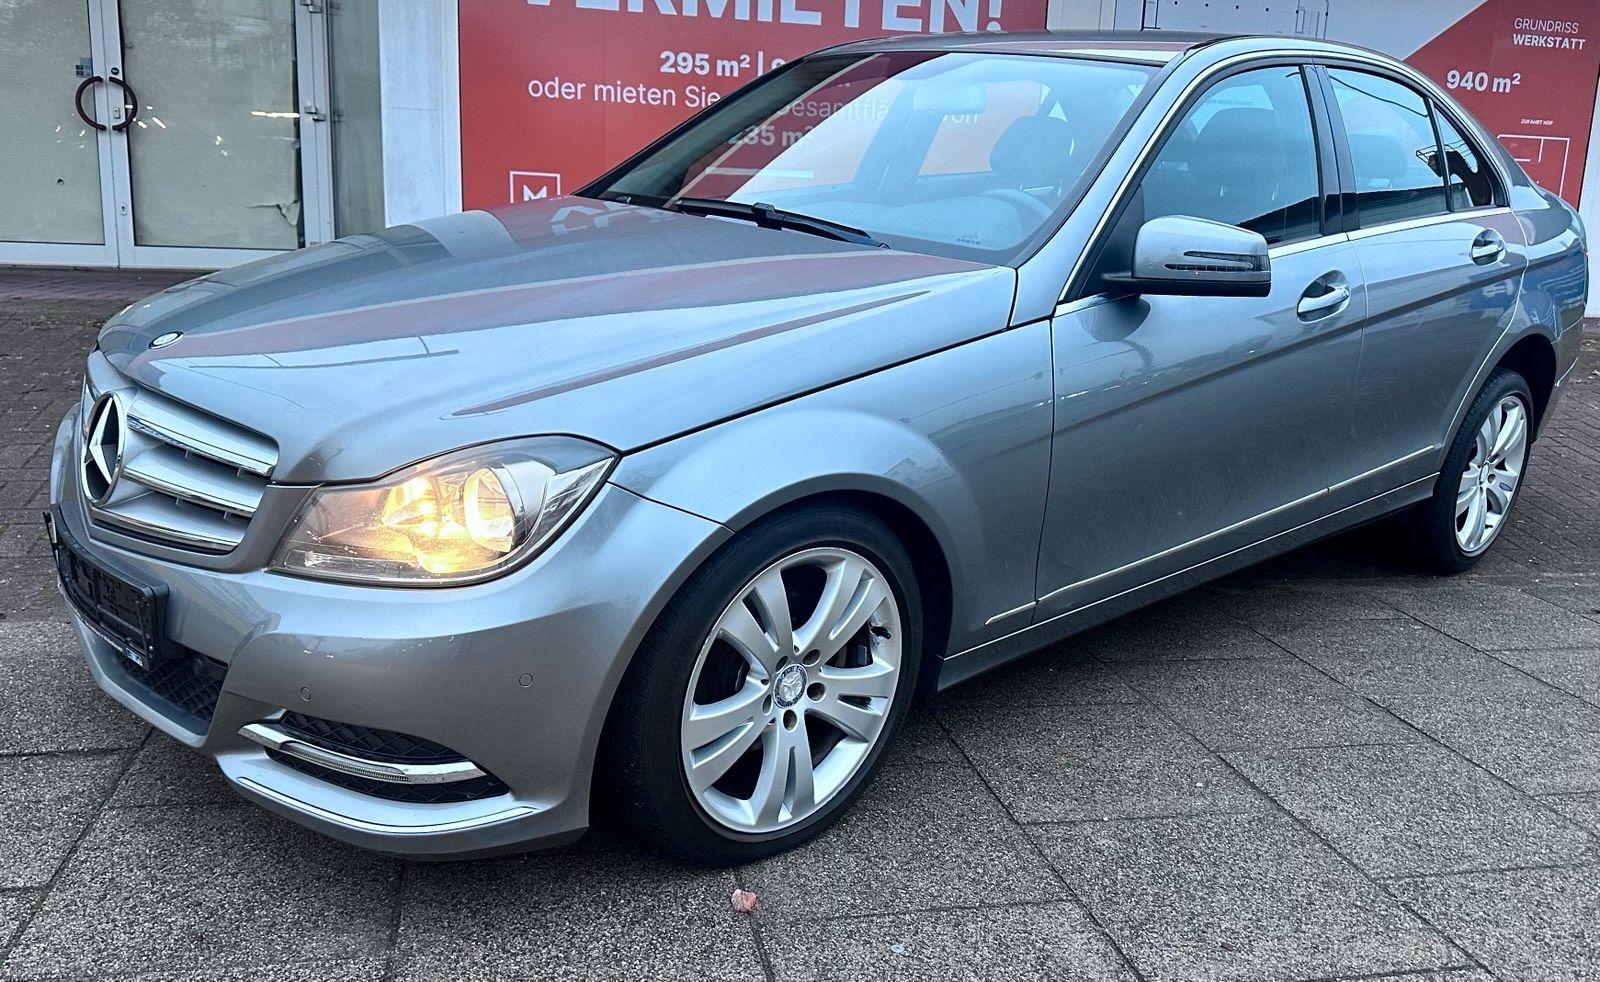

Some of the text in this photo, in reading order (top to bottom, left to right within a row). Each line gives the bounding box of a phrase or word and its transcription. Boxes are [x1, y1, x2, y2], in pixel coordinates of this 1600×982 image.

[1513, 17, 1579, 34] GRUNDRISS
[1512, 33, 1586, 50] WERKSTATT
[660, 50, 710, 76] 295
[716, 53, 751, 77] m²
[527, 76, 721, 108] oder mieten Sie
[1446, 69, 1521, 93] 940 m²
